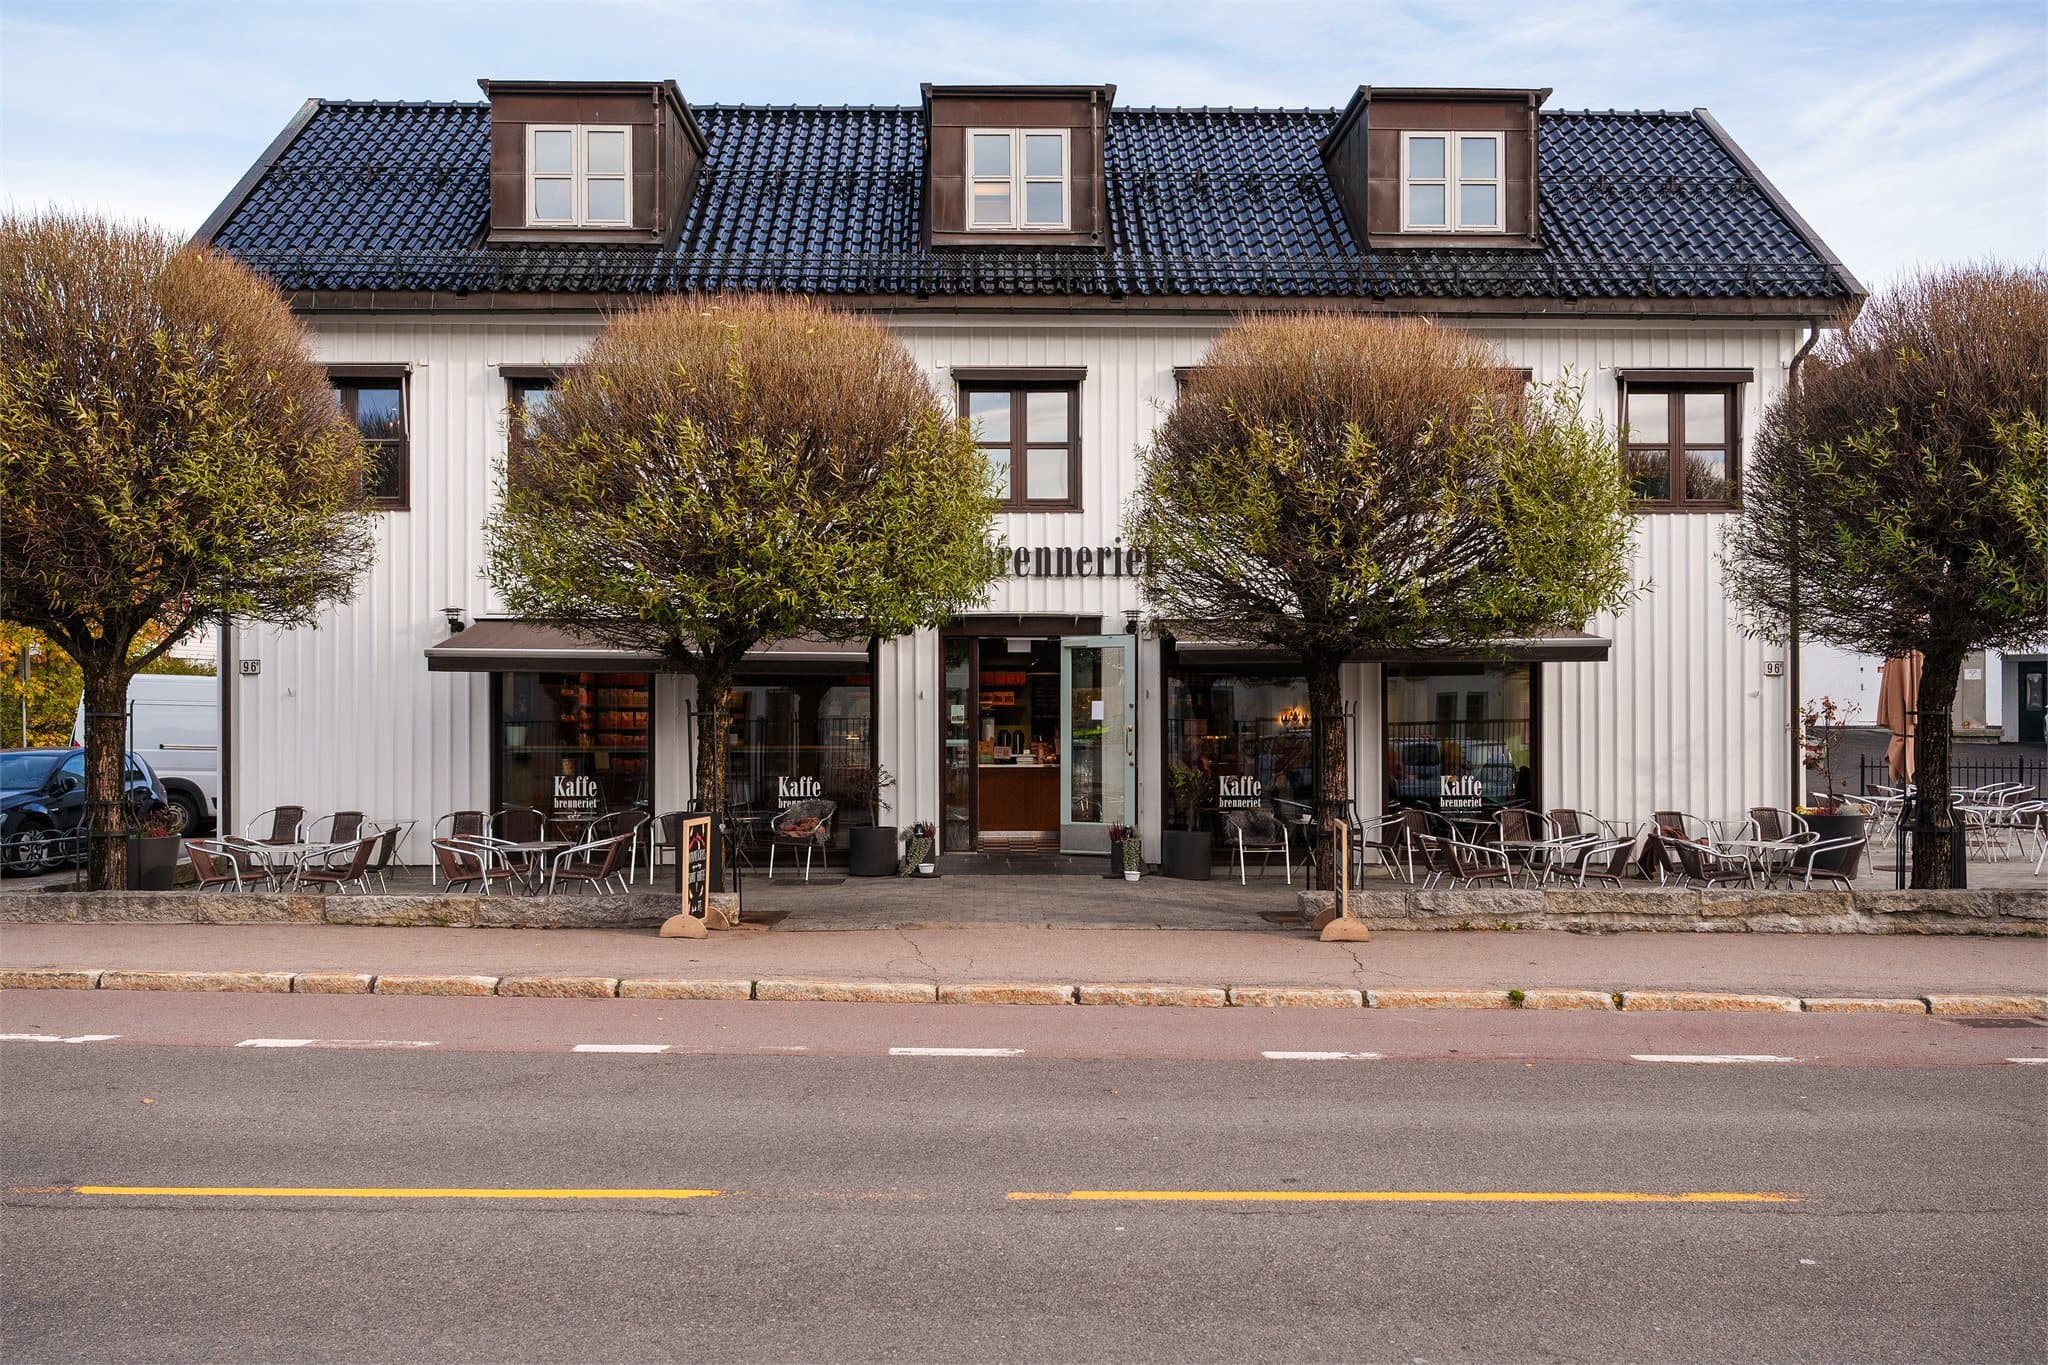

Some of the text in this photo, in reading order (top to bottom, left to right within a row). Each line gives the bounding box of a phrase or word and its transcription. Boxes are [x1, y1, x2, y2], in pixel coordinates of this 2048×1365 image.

[984, 536, 1154, 577] renneriet
[554, 775, 597, 797] Kaffe
[778, 775, 821, 797] Kaffe
[1219, 775, 1262, 797] Kaffe
[1440, 775, 1482, 796] Kaffe
[554, 797, 597, 809] brenneriet
[1219, 796, 1261, 808] brenneriet
[1440, 796, 1482, 808] brenneriet
